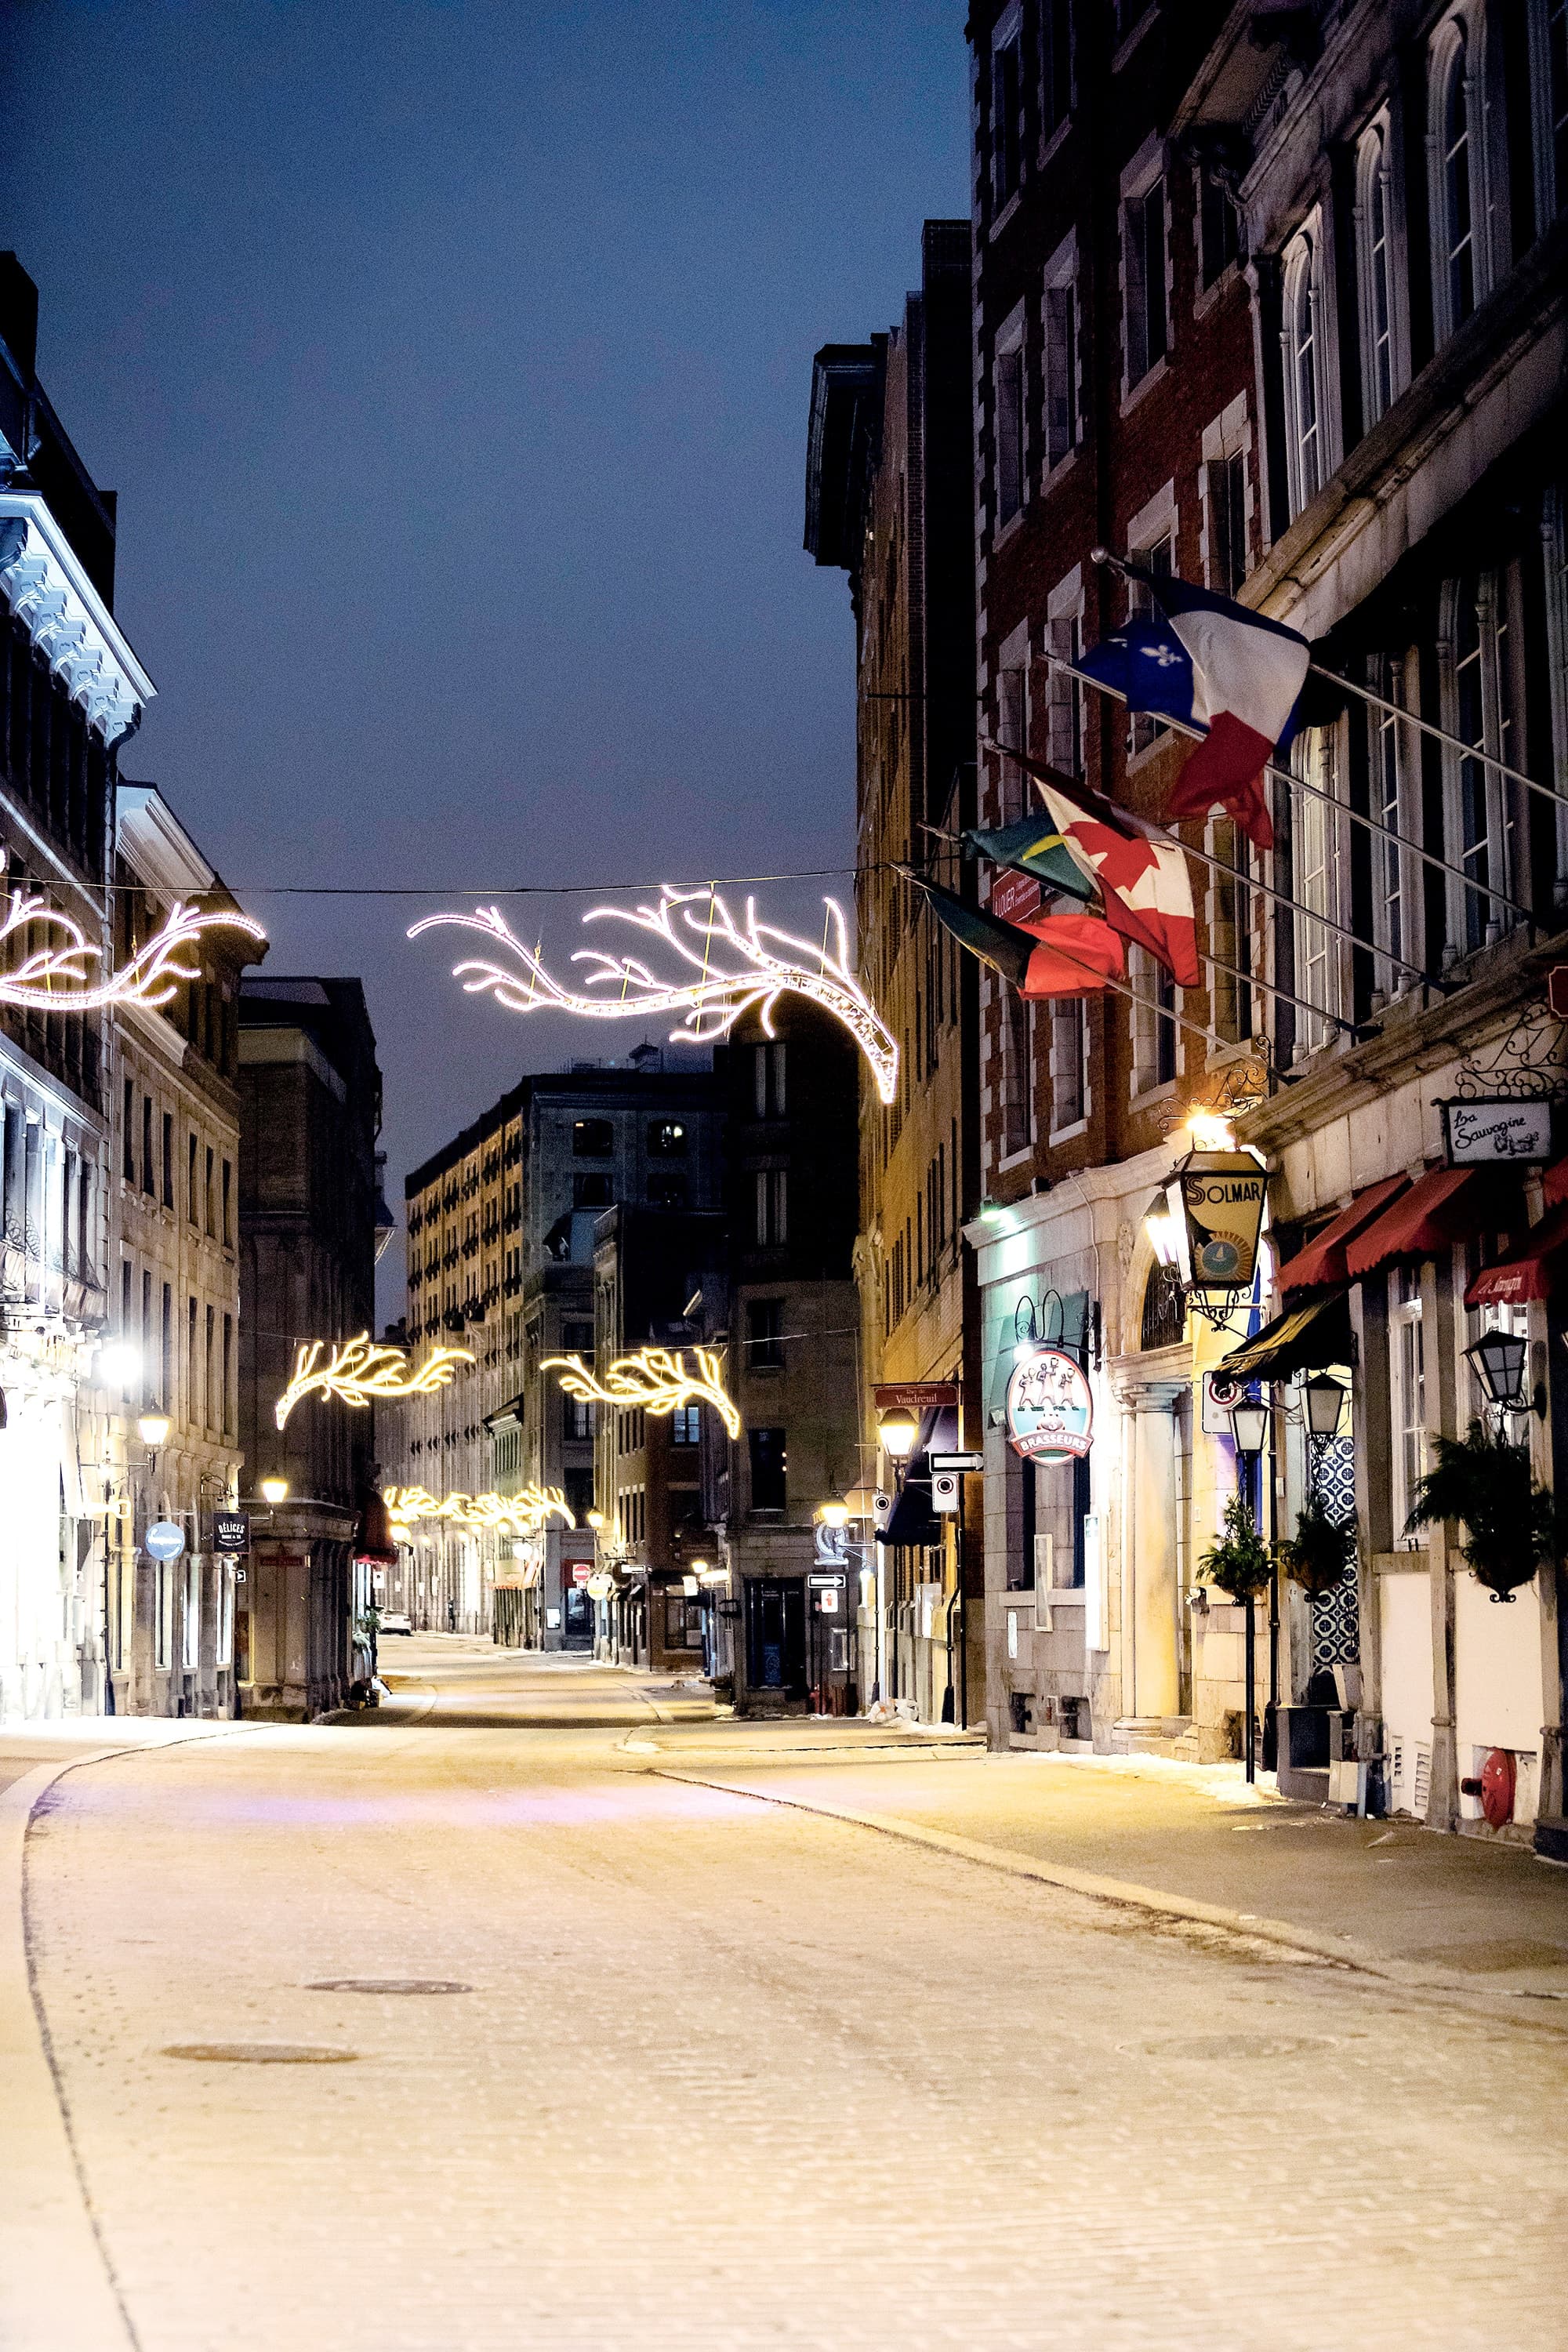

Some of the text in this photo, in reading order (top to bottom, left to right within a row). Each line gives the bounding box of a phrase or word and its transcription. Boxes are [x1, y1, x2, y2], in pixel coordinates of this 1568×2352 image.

[1454, 1110, 1478, 1129] La
[1455, 1117, 1526, 1149] Sauvagine
[895, 1392, 938, 1404] Vaudreuil
[1020, 1434, 1087, 1451] BRASSEURS
